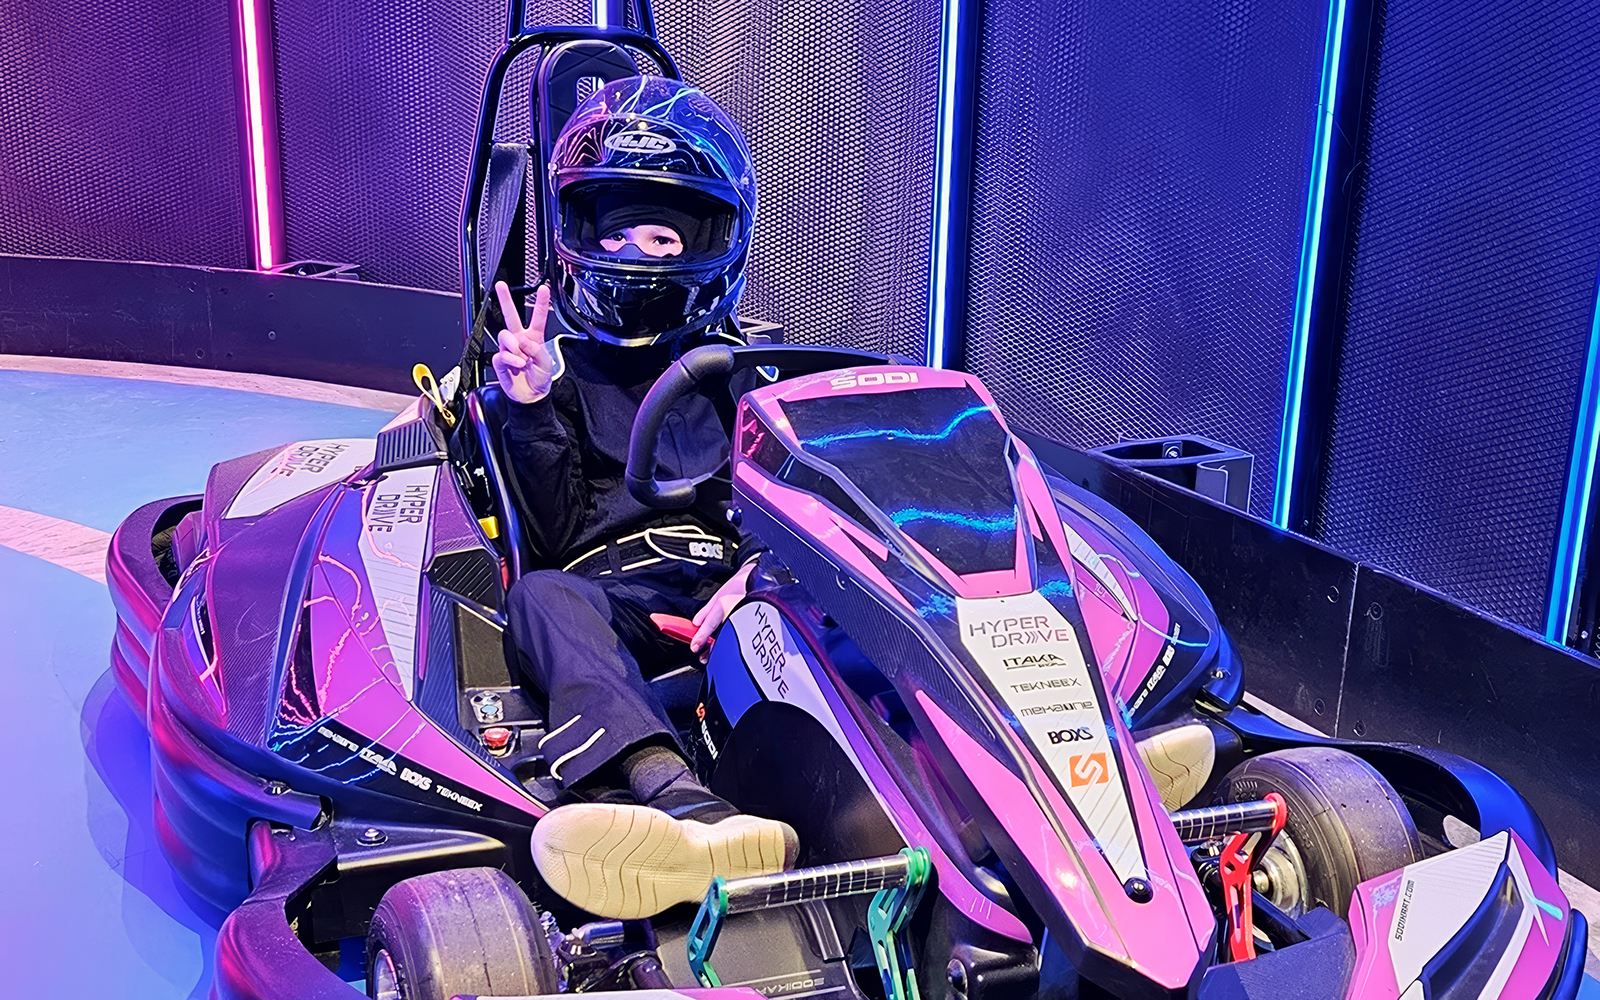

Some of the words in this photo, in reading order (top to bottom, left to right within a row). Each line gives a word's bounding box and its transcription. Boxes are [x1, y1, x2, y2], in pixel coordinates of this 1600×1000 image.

[611, 133, 669, 151] HJC
[829, 371, 919, 391] SODI
[397, 484, 430, 524] HYPER
[969, 615, 1050, 637] HYPER
[754, 603, 786, 673] HYPER
[1002, 653, 1065, 668] ITAKA
[1010, 677, 1082, 694] TEKNEEX
[1047, 726, 1094, 745] BOXS
